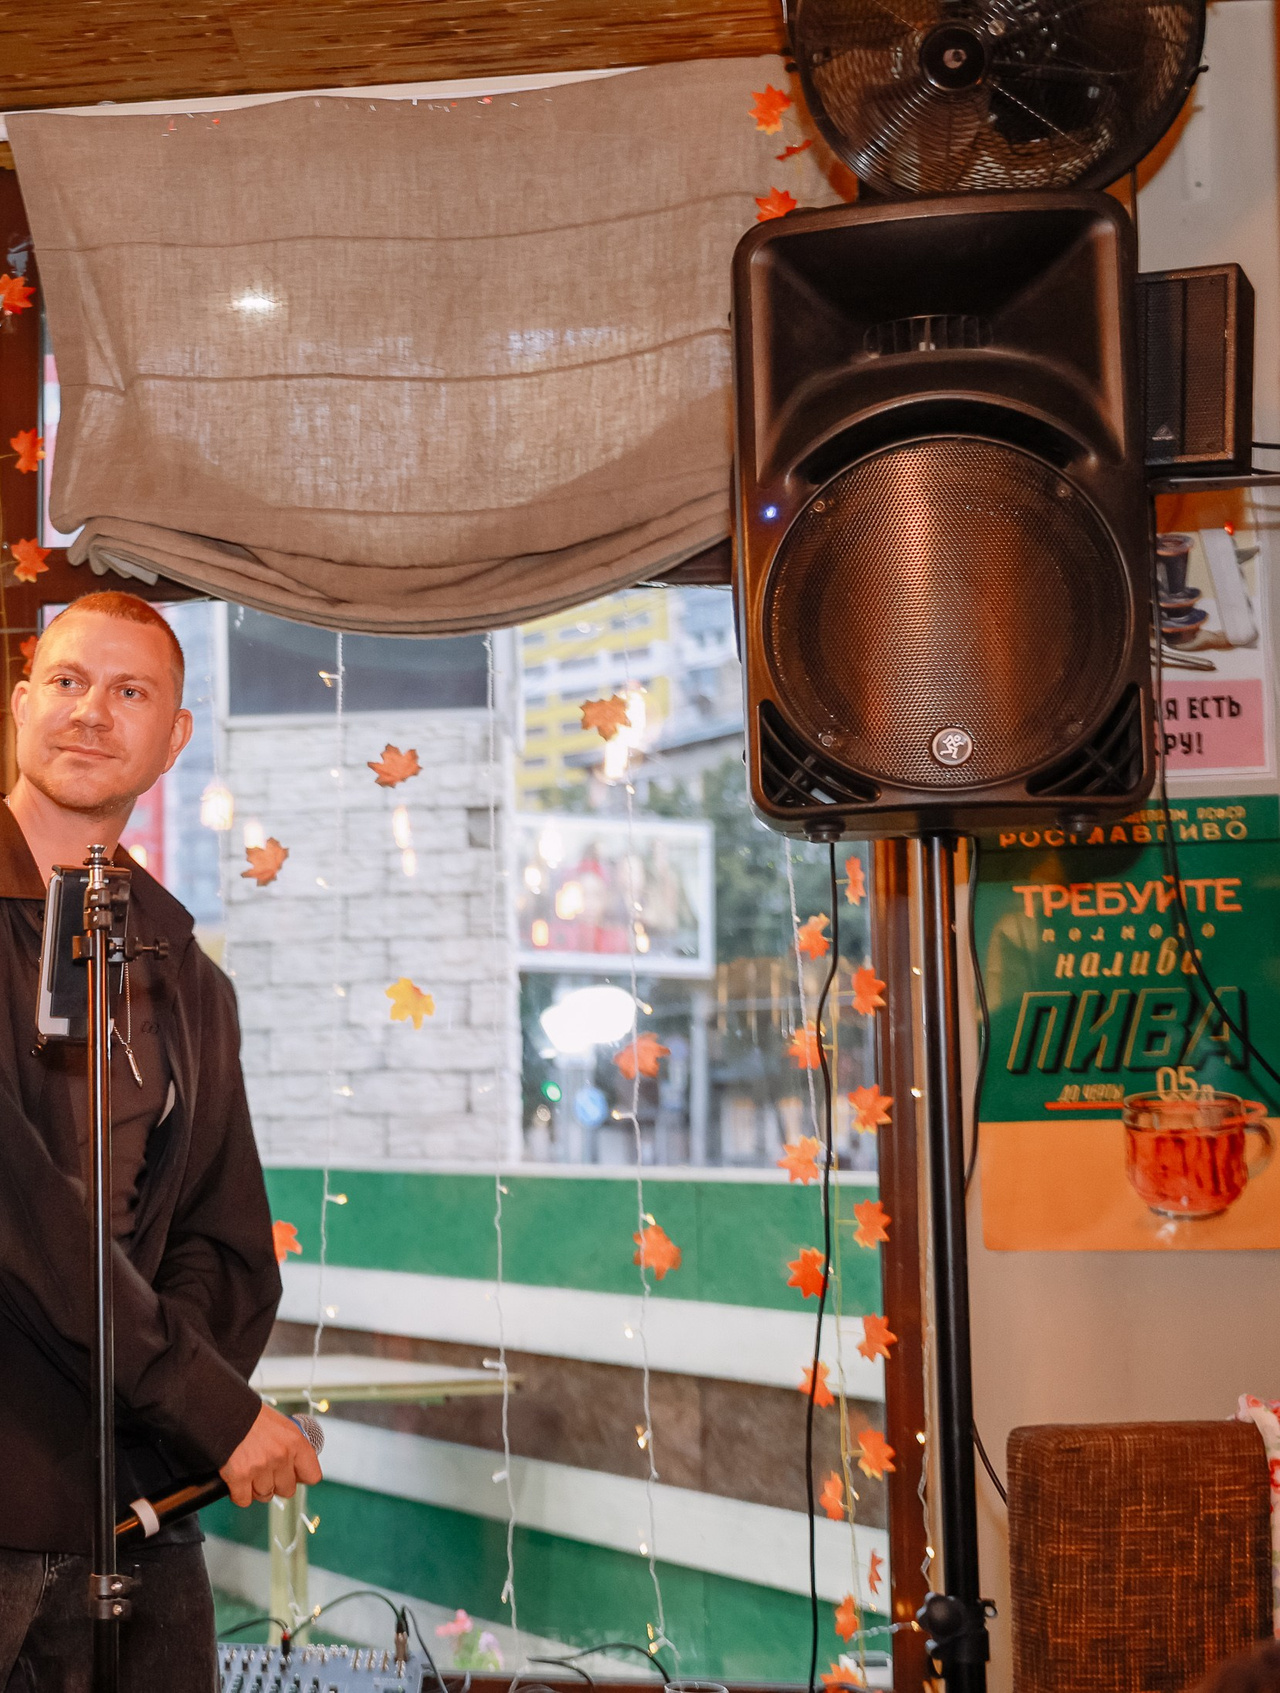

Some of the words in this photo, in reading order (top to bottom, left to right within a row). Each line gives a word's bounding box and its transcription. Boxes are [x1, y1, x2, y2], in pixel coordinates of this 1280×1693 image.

[1188, 695, 1242, 719] ЕСТЬ
[1154, 731, 1203, 756] РУ!
[998, 820, 1250, 848] РОСЛАВИВО
[1012, 875, 1243, 918] ТРЕБУЙТЕ
[1006, 985, 1251, 1075] ПИВА
